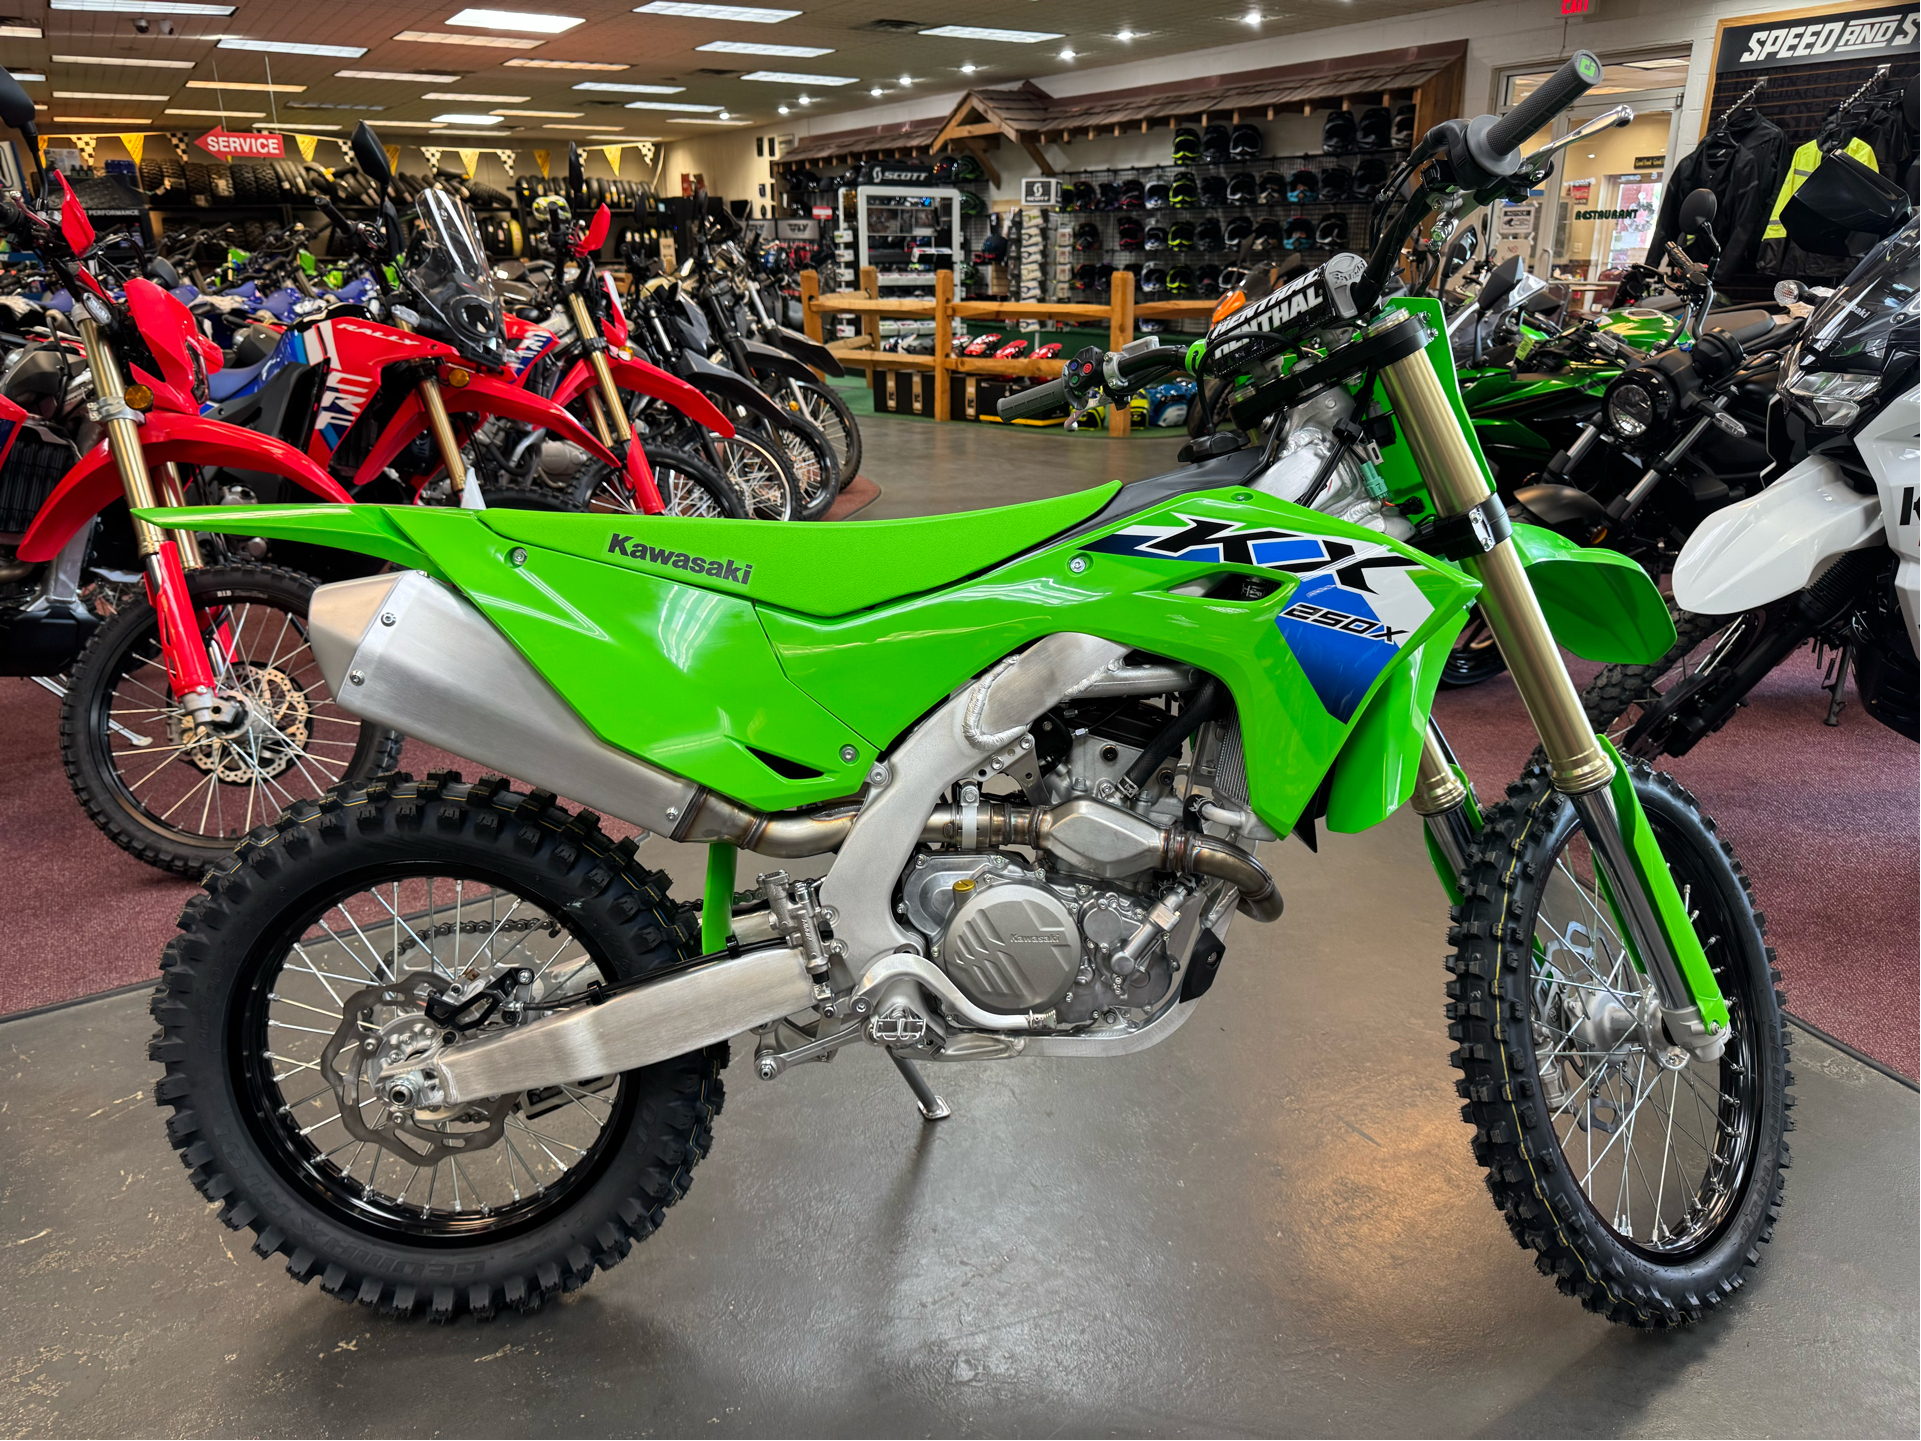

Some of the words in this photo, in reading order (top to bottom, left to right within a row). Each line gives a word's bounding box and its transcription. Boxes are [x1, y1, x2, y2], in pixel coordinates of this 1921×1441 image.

[1740, 22, 1845, 63] SPEED
[1838, 20, 1900, 46] AND
[1891, 12, 1920, 46] S
[207, 136, 280, 154] SERVICE
[883, 171, 929, 182] SCOTT
[1575, 209, 1639, 221] RESTAURANT
[337, 323, 420, 346] RALLY
[607, 532, 753, 585] Kawasaki
[1136, 512, 1428, 597] KX
[1010, 933, 1060, 944] Kawasaki
[288, 1214, 487, 1282] GEOMAX
